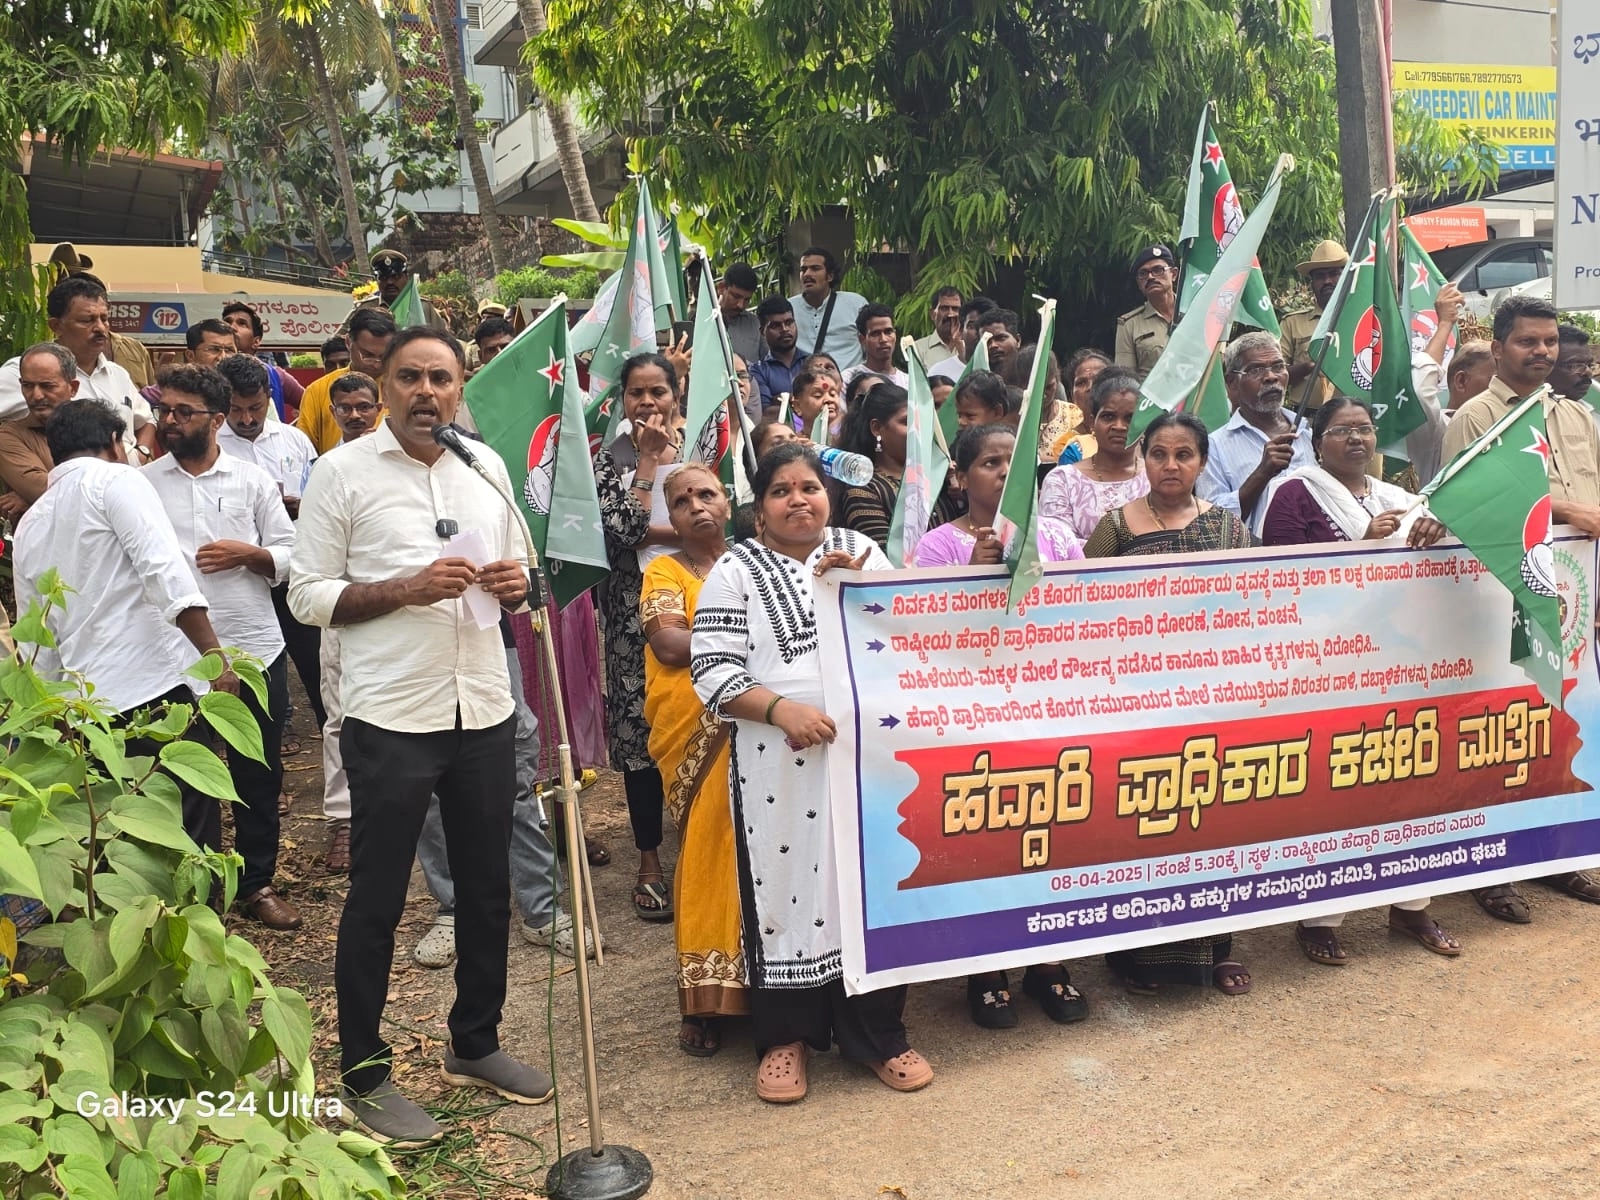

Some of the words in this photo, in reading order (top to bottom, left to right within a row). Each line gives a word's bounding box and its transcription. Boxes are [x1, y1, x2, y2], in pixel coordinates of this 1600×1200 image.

[1406, 88, 1480, 120] HREEDEVI
[1485, 90, 1512, 120] CAR
[158, 312, 179, 327] 112
[892, 592, 948, 615] ನಿರ್ವಸಿತ
[1043, 583, 1083, 605] ಕೊರಗ
[1086, 576, 1167, 602] ಕುಟುಂಬಗಳಿಗೆ
[1170, 572, 1232, 596] ಪರ್ಯಾಯ
[1235, 568, 1271, 599] ವ್ಯವಸ್ಥೆ
[1272, 568, 1301, 595] ಮತ್ತು
[1303, 567, 1326, 586] ತಲಾ
[1329, 567, 1341, 584] 15
[1344, 563, 1364, 589] ಲಕ್ಷ
[1365, 561, 1413, 583] ರೂಪಾಯಿ
[1416, 556, 1459, 583] ಪರಿಹಾರಕ್ಕೆ
[891, 630, 951, 663] ರಾಷ್ಟ್ರೀಯ
[956, 626, 1000, 657] ಹೆದ್ದಾರಿ
[1003, 621, 1075, 651] ಪ್ರಾಧಿಕಾರದ
[1078, 613, 1153, 642] ಸರ್ವಾಧಿಕಾರಿ
[1157, 609, 1209, 638] ಧೋರಣೆ,
[1213, 607, 1254, 629] ಮೋಸ,
[1257, 602, 1302, 626] ವಂಚನೆ,
[1021, 658, 1058, 683] ಮೇಲೆ
[1061, 656, 1116, 684] ದೌರ್ಜನ್ಯ
[1117, 652, 1162, 674] ನಡೆಸಿದ
[1166, 647, 1218, 671] ಕಾನೂನು
[1222, 644, 1261, 666] ಬಾಹಿರ
[1264, 639, 1322, 670] ಕೃತ್ಯಗಳನ್ನು
[906, 705, 950, 736] ಹೆದ್ದಾರಿ
[952, 700, 1043, 730] ಪ್ರಾಧಿಕಾರದಿಂದ
[1045, 696, 1087, 719] ಕೊರಗ
[1088, 688, 1172, 715] ಸಮುದಾಯದ
[1175, 683, 1210, 707] ಮೇಲೆ
[1212, 678, 1289, 708] ನಡೆಯುತ್ತಿರುವ
[1291, 674, 1330, 695] ನಿರಂತರ
[1333, 671, 1358, 691] ದಾಳಿ,
[1360, 663, 1429, 694] ದಬ್ಬಾಳಿಕೆಗಳನ್ನು
[1430, 657, 1474, 680] ವಿರೋಧಿಸಿ
[943, 746, 1092, 870] ಹೆದ್ದಾರಿ
[1117, 729, 1312, 838] ಪ್ರಾಧಿಕಾರ
[1330, 707, 1440, 790] ಕಚೇರಿ
[1051, 866, 1143, 891] 08-04-2025
[1155, 856, 1191, 878] ಸಂಜೆ
[1194, 850, 1238, 873] 5.30ಕ್ಕೆ
[1248, 846, 1271, 871] ಸ್ಥಳ
[1282, 836, 1338, 863] ರಾಷ್ಟ್ರೀಯ
[1341, 829, 1380, 852] ಹೆದ್ದಾರಿ
[1384, 818, 1446, 845] ಪ್ರಾಧಿಕಾರದ
[1449, 812, 1486, 832] ಎದುರು
[1027, 903, 1108, 933] ಕರ್ನಾಟಕ
[1112, 893, 1186, 920] ಆದಿವಾಸಿ
[1190, 881, 1253, 912] ಹಕ್ಕುಗಳ
[1256, 869, 1327, 899] ಸಮನ್ವಯ
[1330, 863, 1377, 886] ಸಮಿತಿ,
[1380, 846, 1468, 878] ವಾಮಂಜೂರು
[1471, 839, 1507, 865] ಘಟಕ
